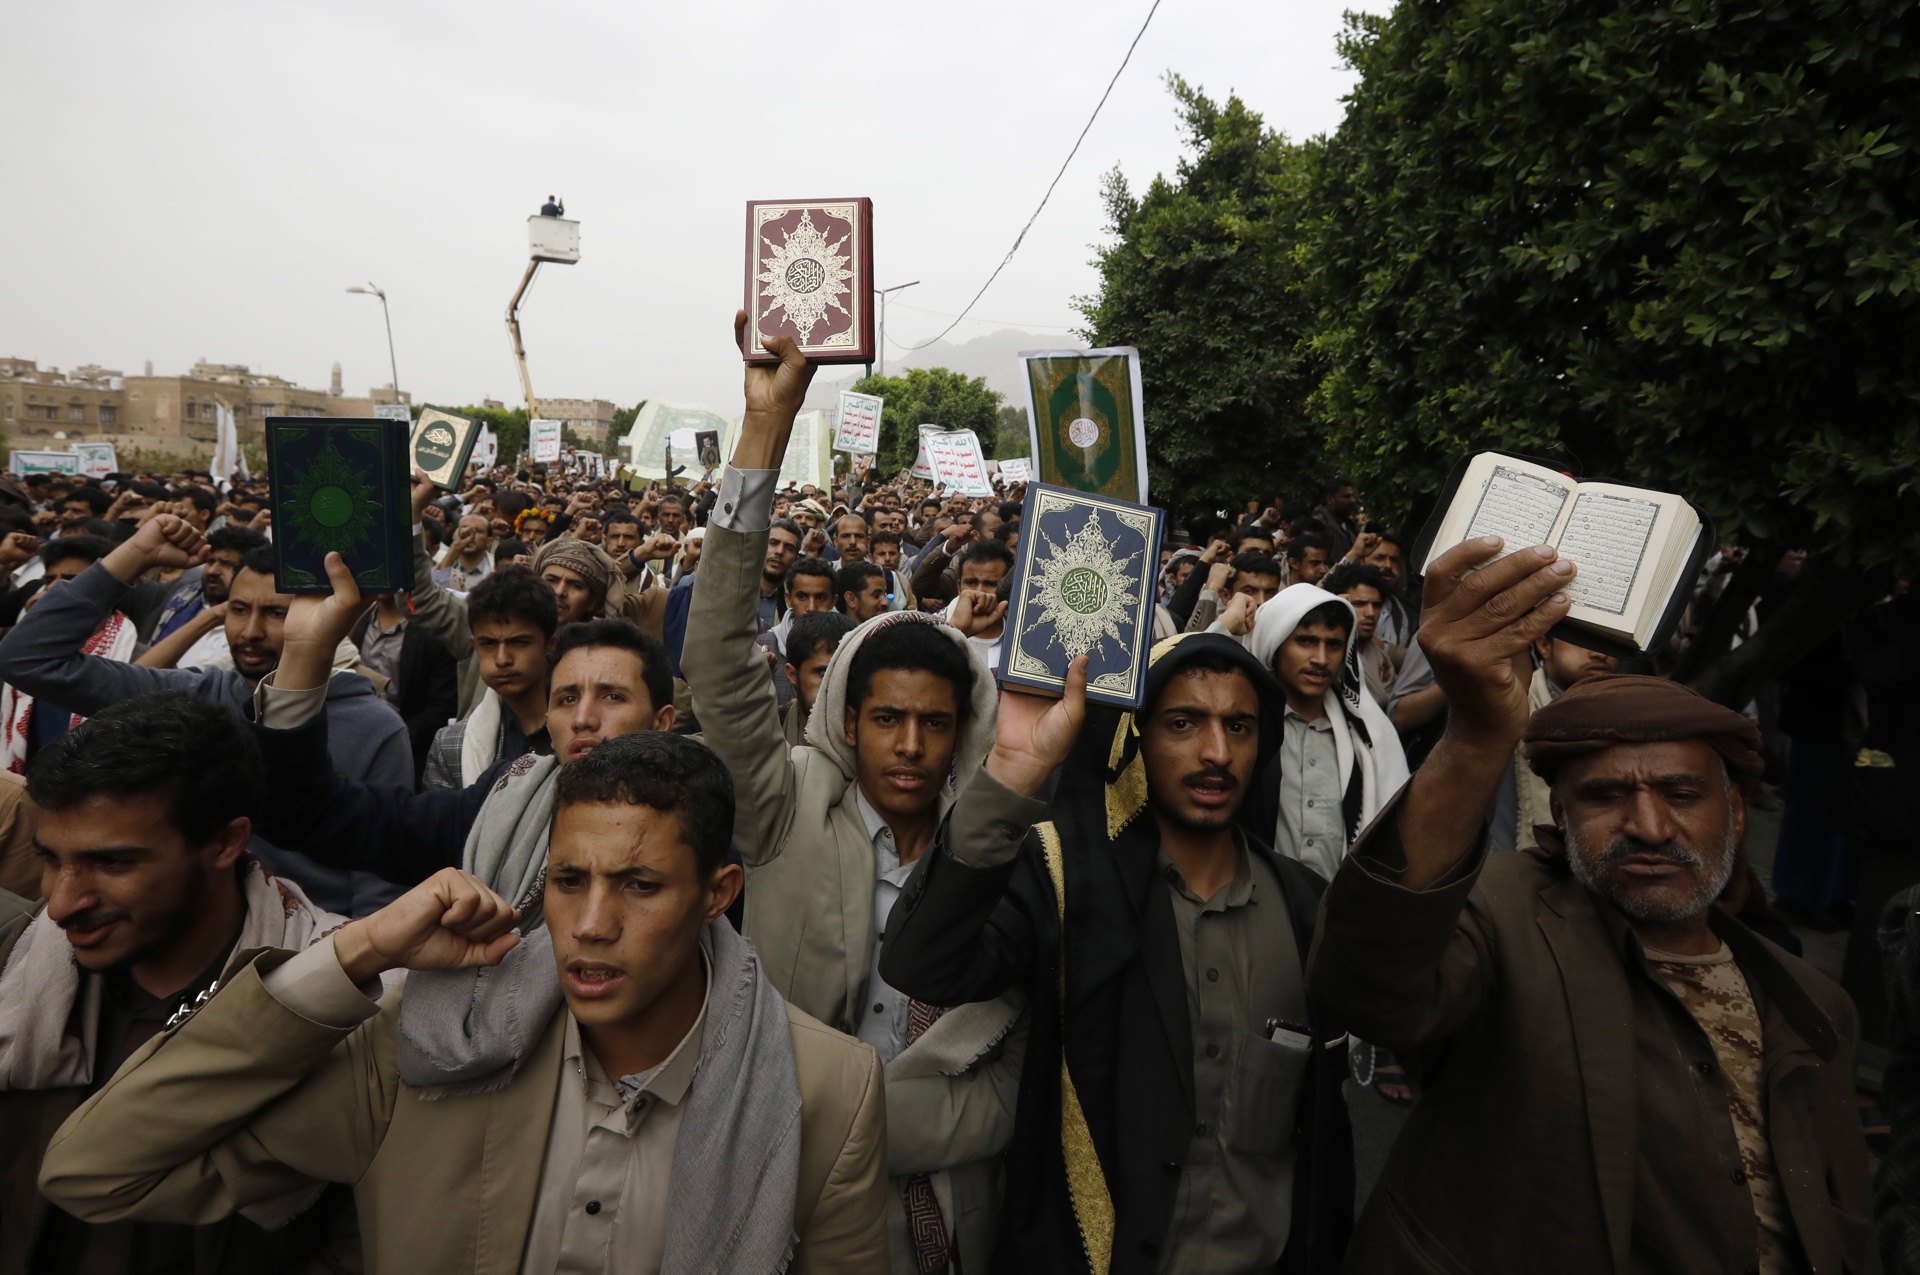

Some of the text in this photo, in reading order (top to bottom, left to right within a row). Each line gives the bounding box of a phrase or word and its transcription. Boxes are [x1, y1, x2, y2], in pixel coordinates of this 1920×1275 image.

[864, 402, 877, 412] الله
[955, 436, 972, 446] الله
[1066, 578, 1106, 613] القرآن
